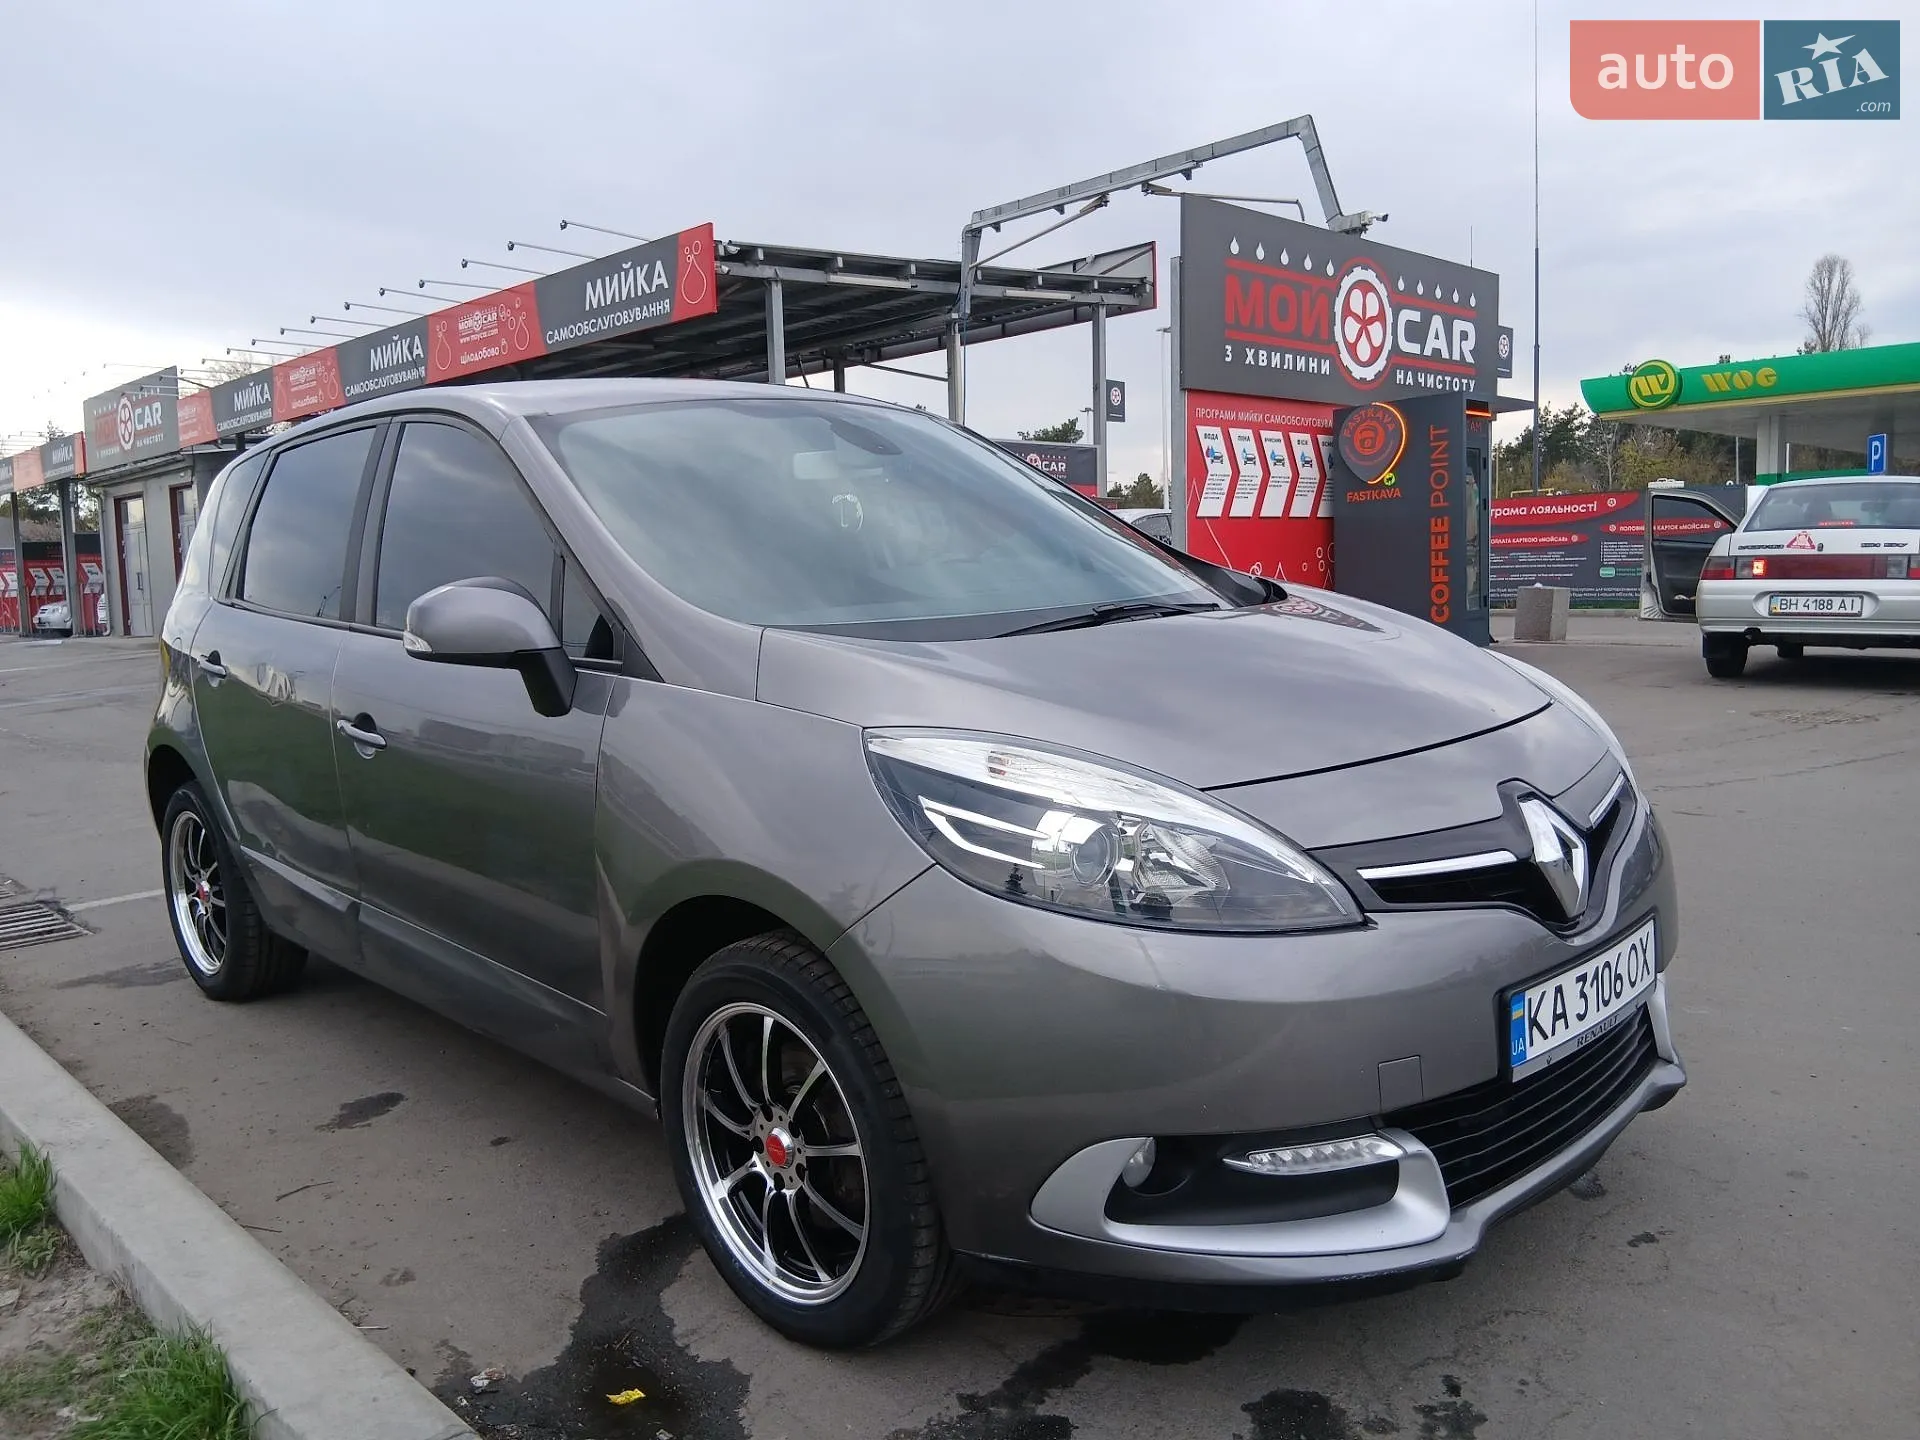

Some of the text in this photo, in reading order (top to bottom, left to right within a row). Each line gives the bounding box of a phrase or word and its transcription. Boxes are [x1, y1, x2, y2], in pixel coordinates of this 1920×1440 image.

[585, 260, 669, 311] МИЙКА
[546, 299, 671, 344] САМООБСЛУГОВУВАННЯ
[1397, 309, 1475, 364] CAR
[370, 334, 424, 372] МИЙКА
[1225, 344, 1330, 375] 3 ХВИЛИНИ
[344, 366, 426, 397] САМООБСЛУГОВУВАННЯ
[1701, 367, 1777, 393] WOG
[234, 381, 271, 412] МИЙКА
[135, 402, 162, 430] CAR
[1195, 407, 1236, 421] ПРОГРАМИ
[1238, 410, 1263, 422] МИЙКИ
[1042, 461, 1066, 472] CAR
[1872, 440, 1881, 471] P
[1347, 487, 1402, 503] FASTKAVA
[1530, 501, 1597, 514] лояльності
[1430, 424, 1450, 623] COFFEE POINT
[1780, 599, 1854, 611] BH 4188 AI
[1528, 932, 1650, 1047] KA 3106 OX
[1512, 1037, 1525, 1056] UA
[1577, 1015, 1619, 1048] RENAULT
